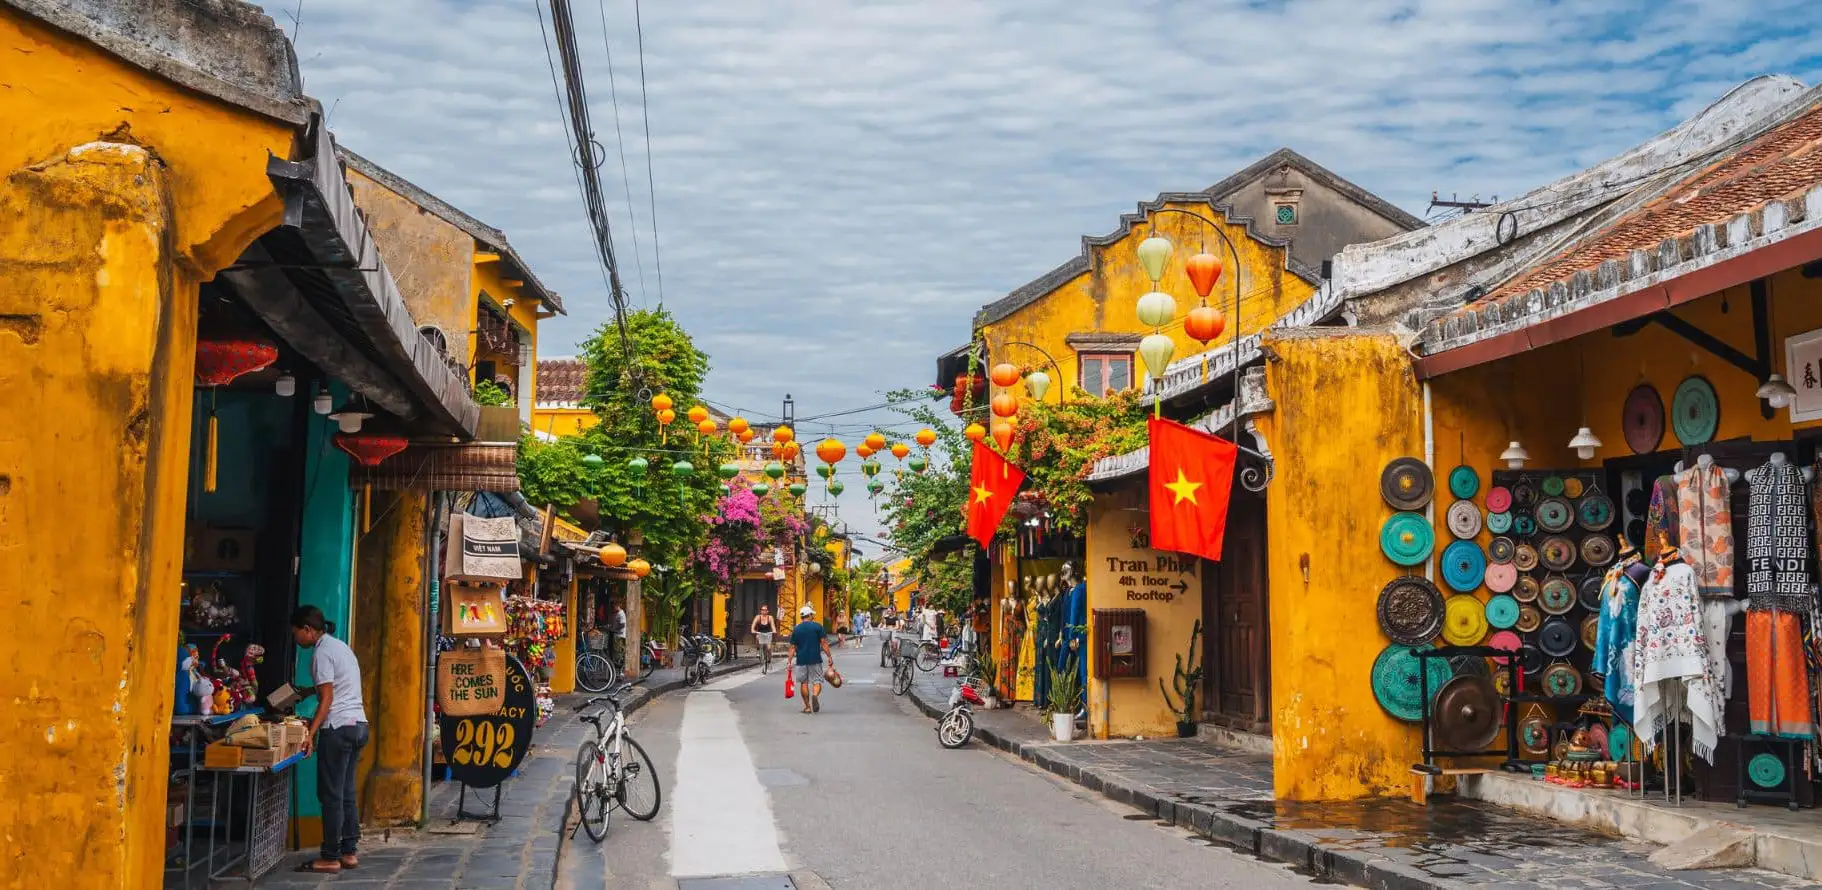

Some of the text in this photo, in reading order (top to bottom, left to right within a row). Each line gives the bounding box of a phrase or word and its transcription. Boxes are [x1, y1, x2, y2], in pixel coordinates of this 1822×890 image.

[1106, 557, 1148, 572] Tran
[1752, 558, 1805, 571] FENDI
[1119, 576, 1169, 586] 4th floor
[1126, 590, 1173, 603] Rooftop
[451, 664, 474, 675] HERE
[455, 675, 493, 688] COMES
[450, 687, 498, 700] THE SUN
[453, 719, 516, 768] 292
